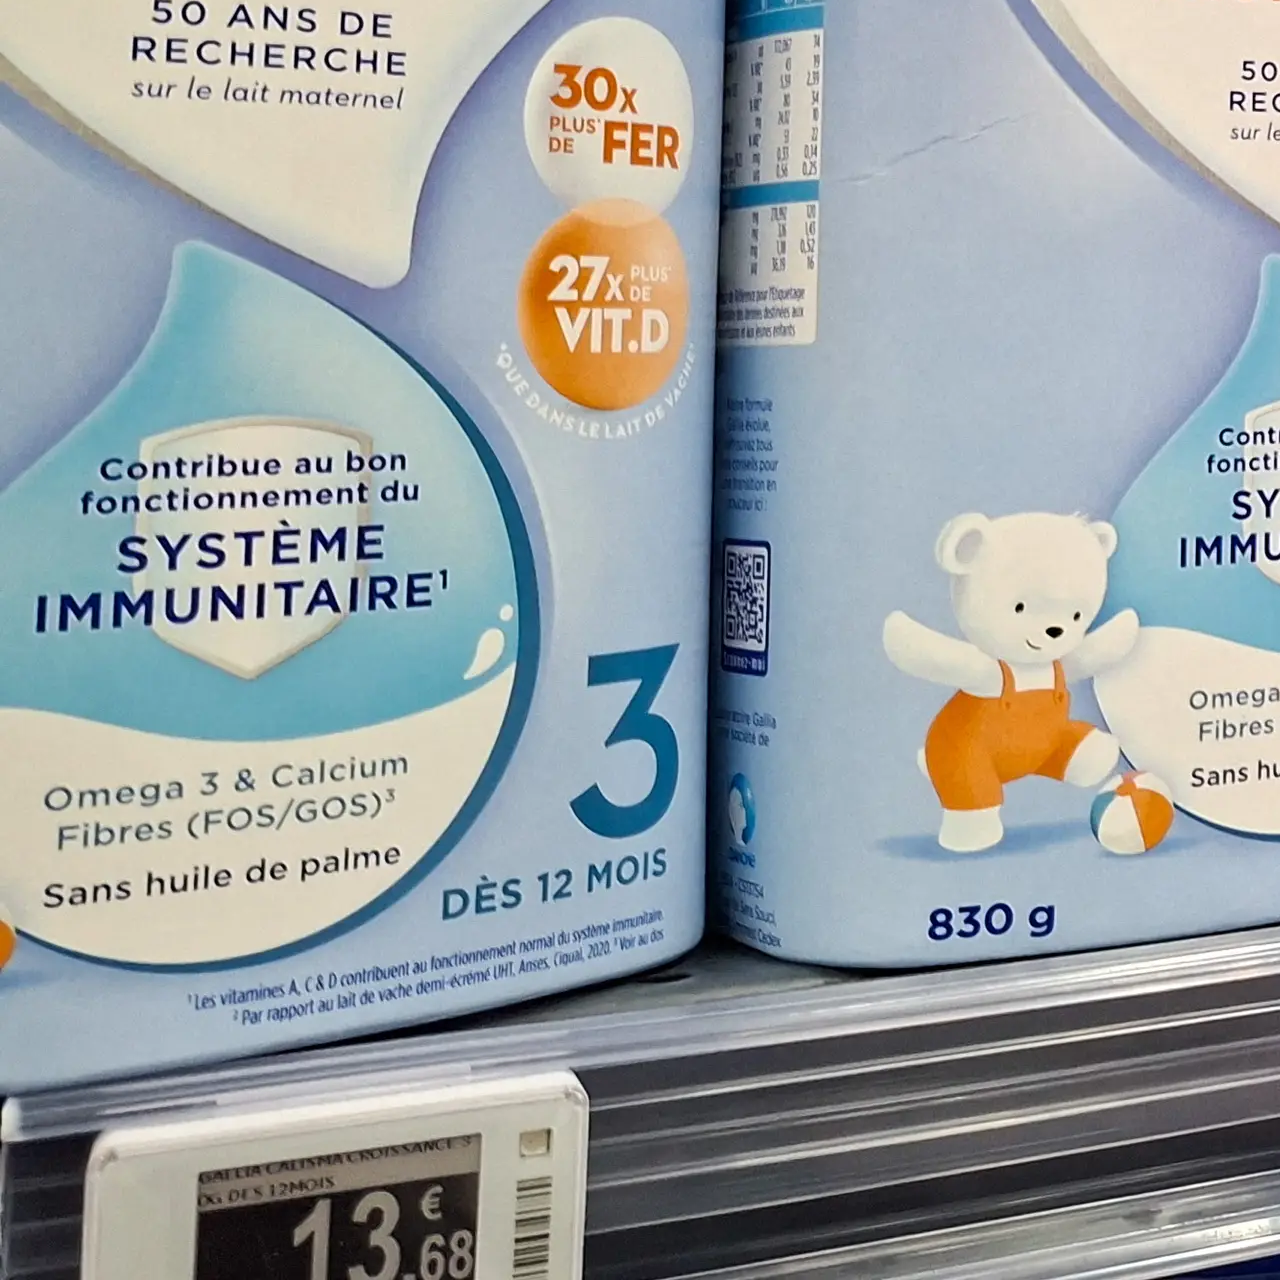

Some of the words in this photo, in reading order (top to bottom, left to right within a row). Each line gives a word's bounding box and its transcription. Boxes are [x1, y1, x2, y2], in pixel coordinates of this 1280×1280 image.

[228, 3, 320, 34] ANS
[341, 11, 394, 39] DE
[130, 36, 408, 76] RECHERCHE
[130, 78, 178, 102] sur
[189, 78, 214, 103] le
[224, 79, 270, 104] lait
[279, 84, 405, 111] maternel
[602, 120, 680, 170] FER
[555, 308, 670, 354] VIT.D
[99, 453, 282, 481] Contribue
[294, 453, 334, 476] au
[345, 449, 408, 474] bon
[80, 482, 370, 517] fonctionnement
[380, 478, 420, 505] du
[116, 521, 386, 575] SYSTÈME
[569, 642, 680, 839] 3
[42, 775, 183, 812] Omega
[200, 770, 219, 797] 3
[271, 753, 409, 789] Calcium
[56, 816, 173, 851] Fibres
[42, 876, 136, 911] Sans
[146, 864, 232, 897] huile
[245, 856, 288, 886] de
[300, 844, 401, 882] palme
[442, 872, 524, 920] DÈS
[538, 868, 572, 905] 12
[584, 848, 669, 897] MOIS
[926, 903, 1015, 942] 830
[1029, 901, 1056, 938] g
[220, 982, 286, 1008] vitamines
[340, 960, 409, 989] contribuent
[431, 940, 517, 973] fonctionnement
[266, 1000, 316, 1025] rapport
[416, 967, 492, 998] demi-écrémé
[421, 1185, 444, 1221] €
